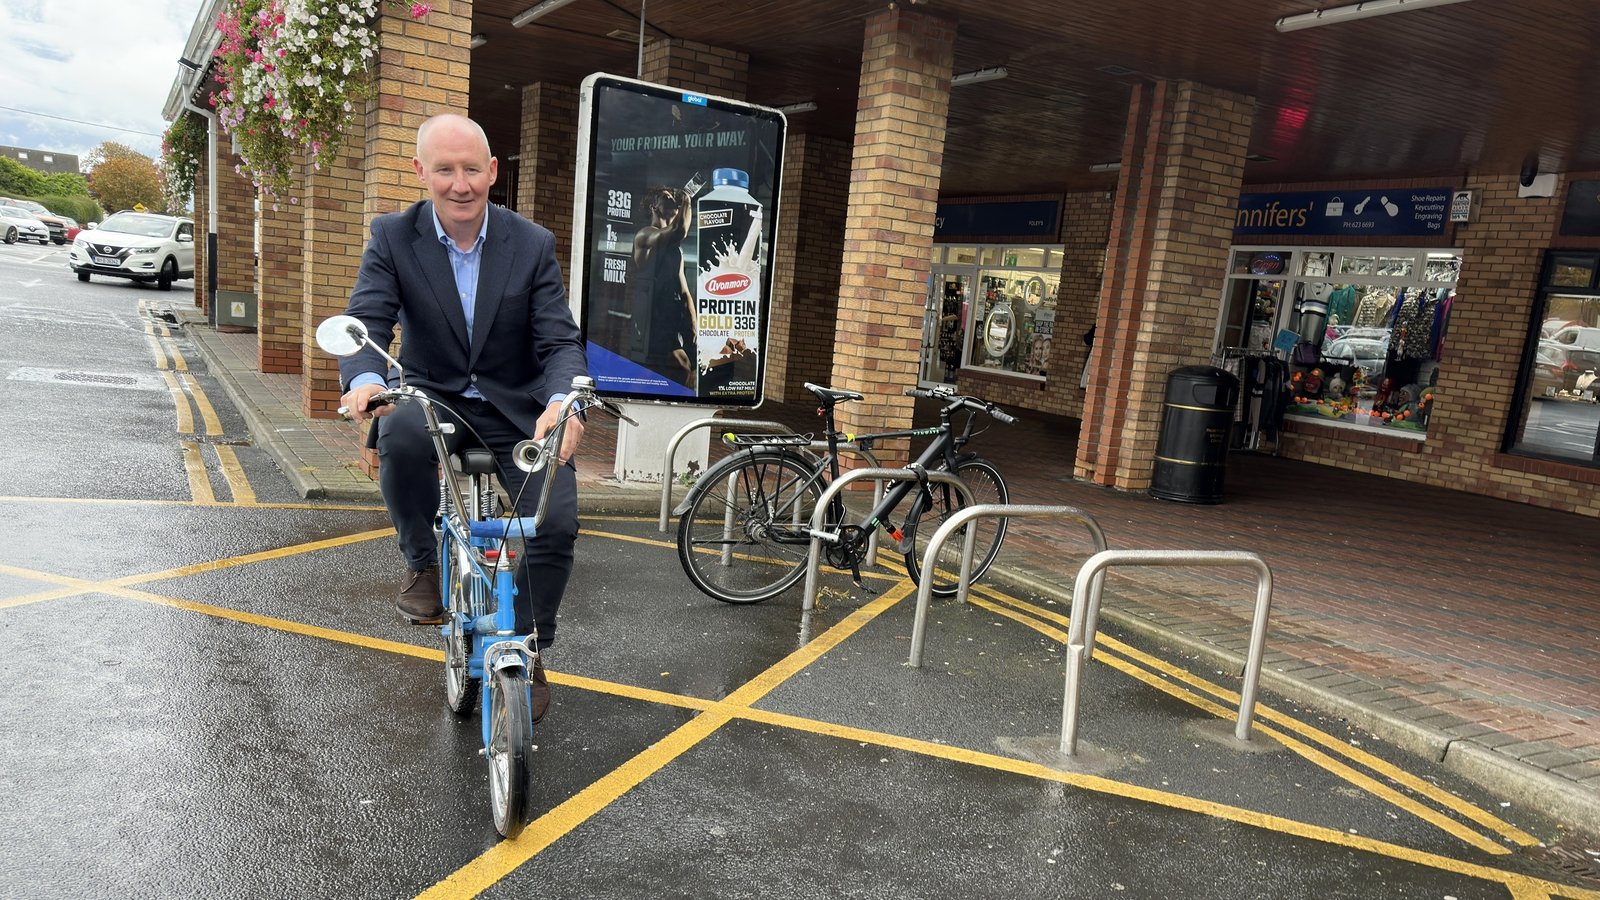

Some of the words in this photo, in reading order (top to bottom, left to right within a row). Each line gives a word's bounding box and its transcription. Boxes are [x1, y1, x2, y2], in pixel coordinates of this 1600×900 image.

[611, 138, 635, 151] YOUR
[637, 135, 681, 150] PROTEIN.
[685, 133, 714, 148] YOUR
[717, 131, 746, 146] WAY.
[608, 190, 631, 209] 33G
[1426, 195, 1446, 203] Repairs
[607, 207, 630, 218] PROTEIN
[1415, 213, 1442, 221] Engraving
[606, 224, 617, 241] 1%
[606, 241, 616, 250] FAT
[604, 258, 626, 271] FRESH
[603, 269, 626, 284] MILK
[699, 299, 756, 315] PROTEIN
[700, 315, 733, 330] GOLD
[735, 317, 756, 330] 33G
